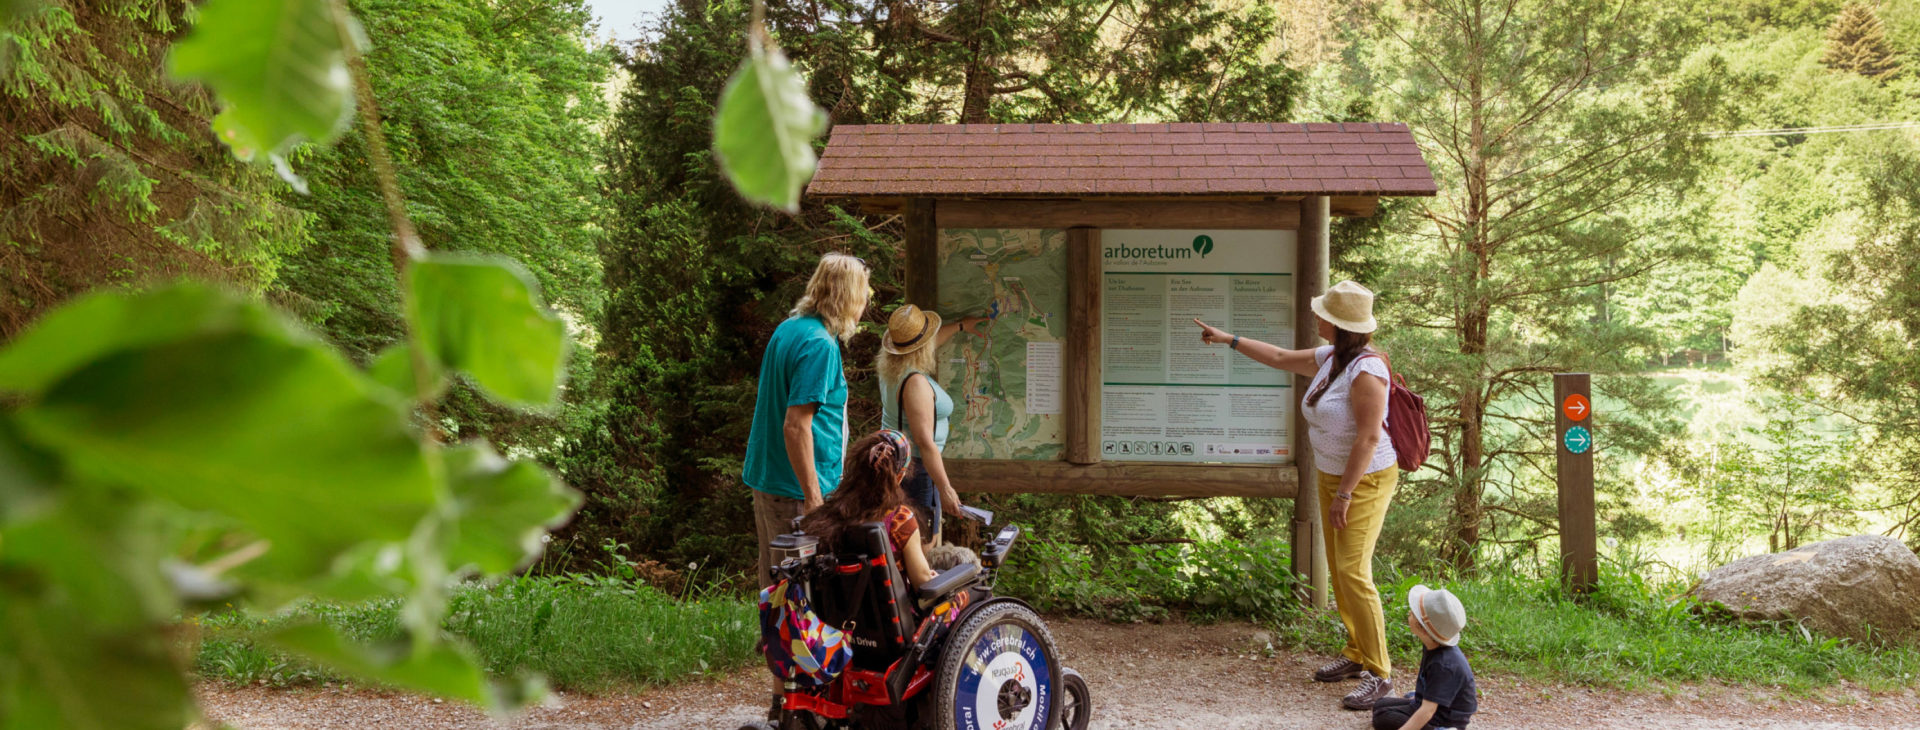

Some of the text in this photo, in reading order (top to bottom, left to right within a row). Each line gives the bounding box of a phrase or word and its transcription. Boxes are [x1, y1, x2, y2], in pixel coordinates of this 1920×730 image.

[1104, 242, 1192, 259] arboretum
[856, 636, 877, 648] Drive
[970, 634, 1037, 677] www.cerebral.ch
[1036, 684, 1046, 723] Mobil
